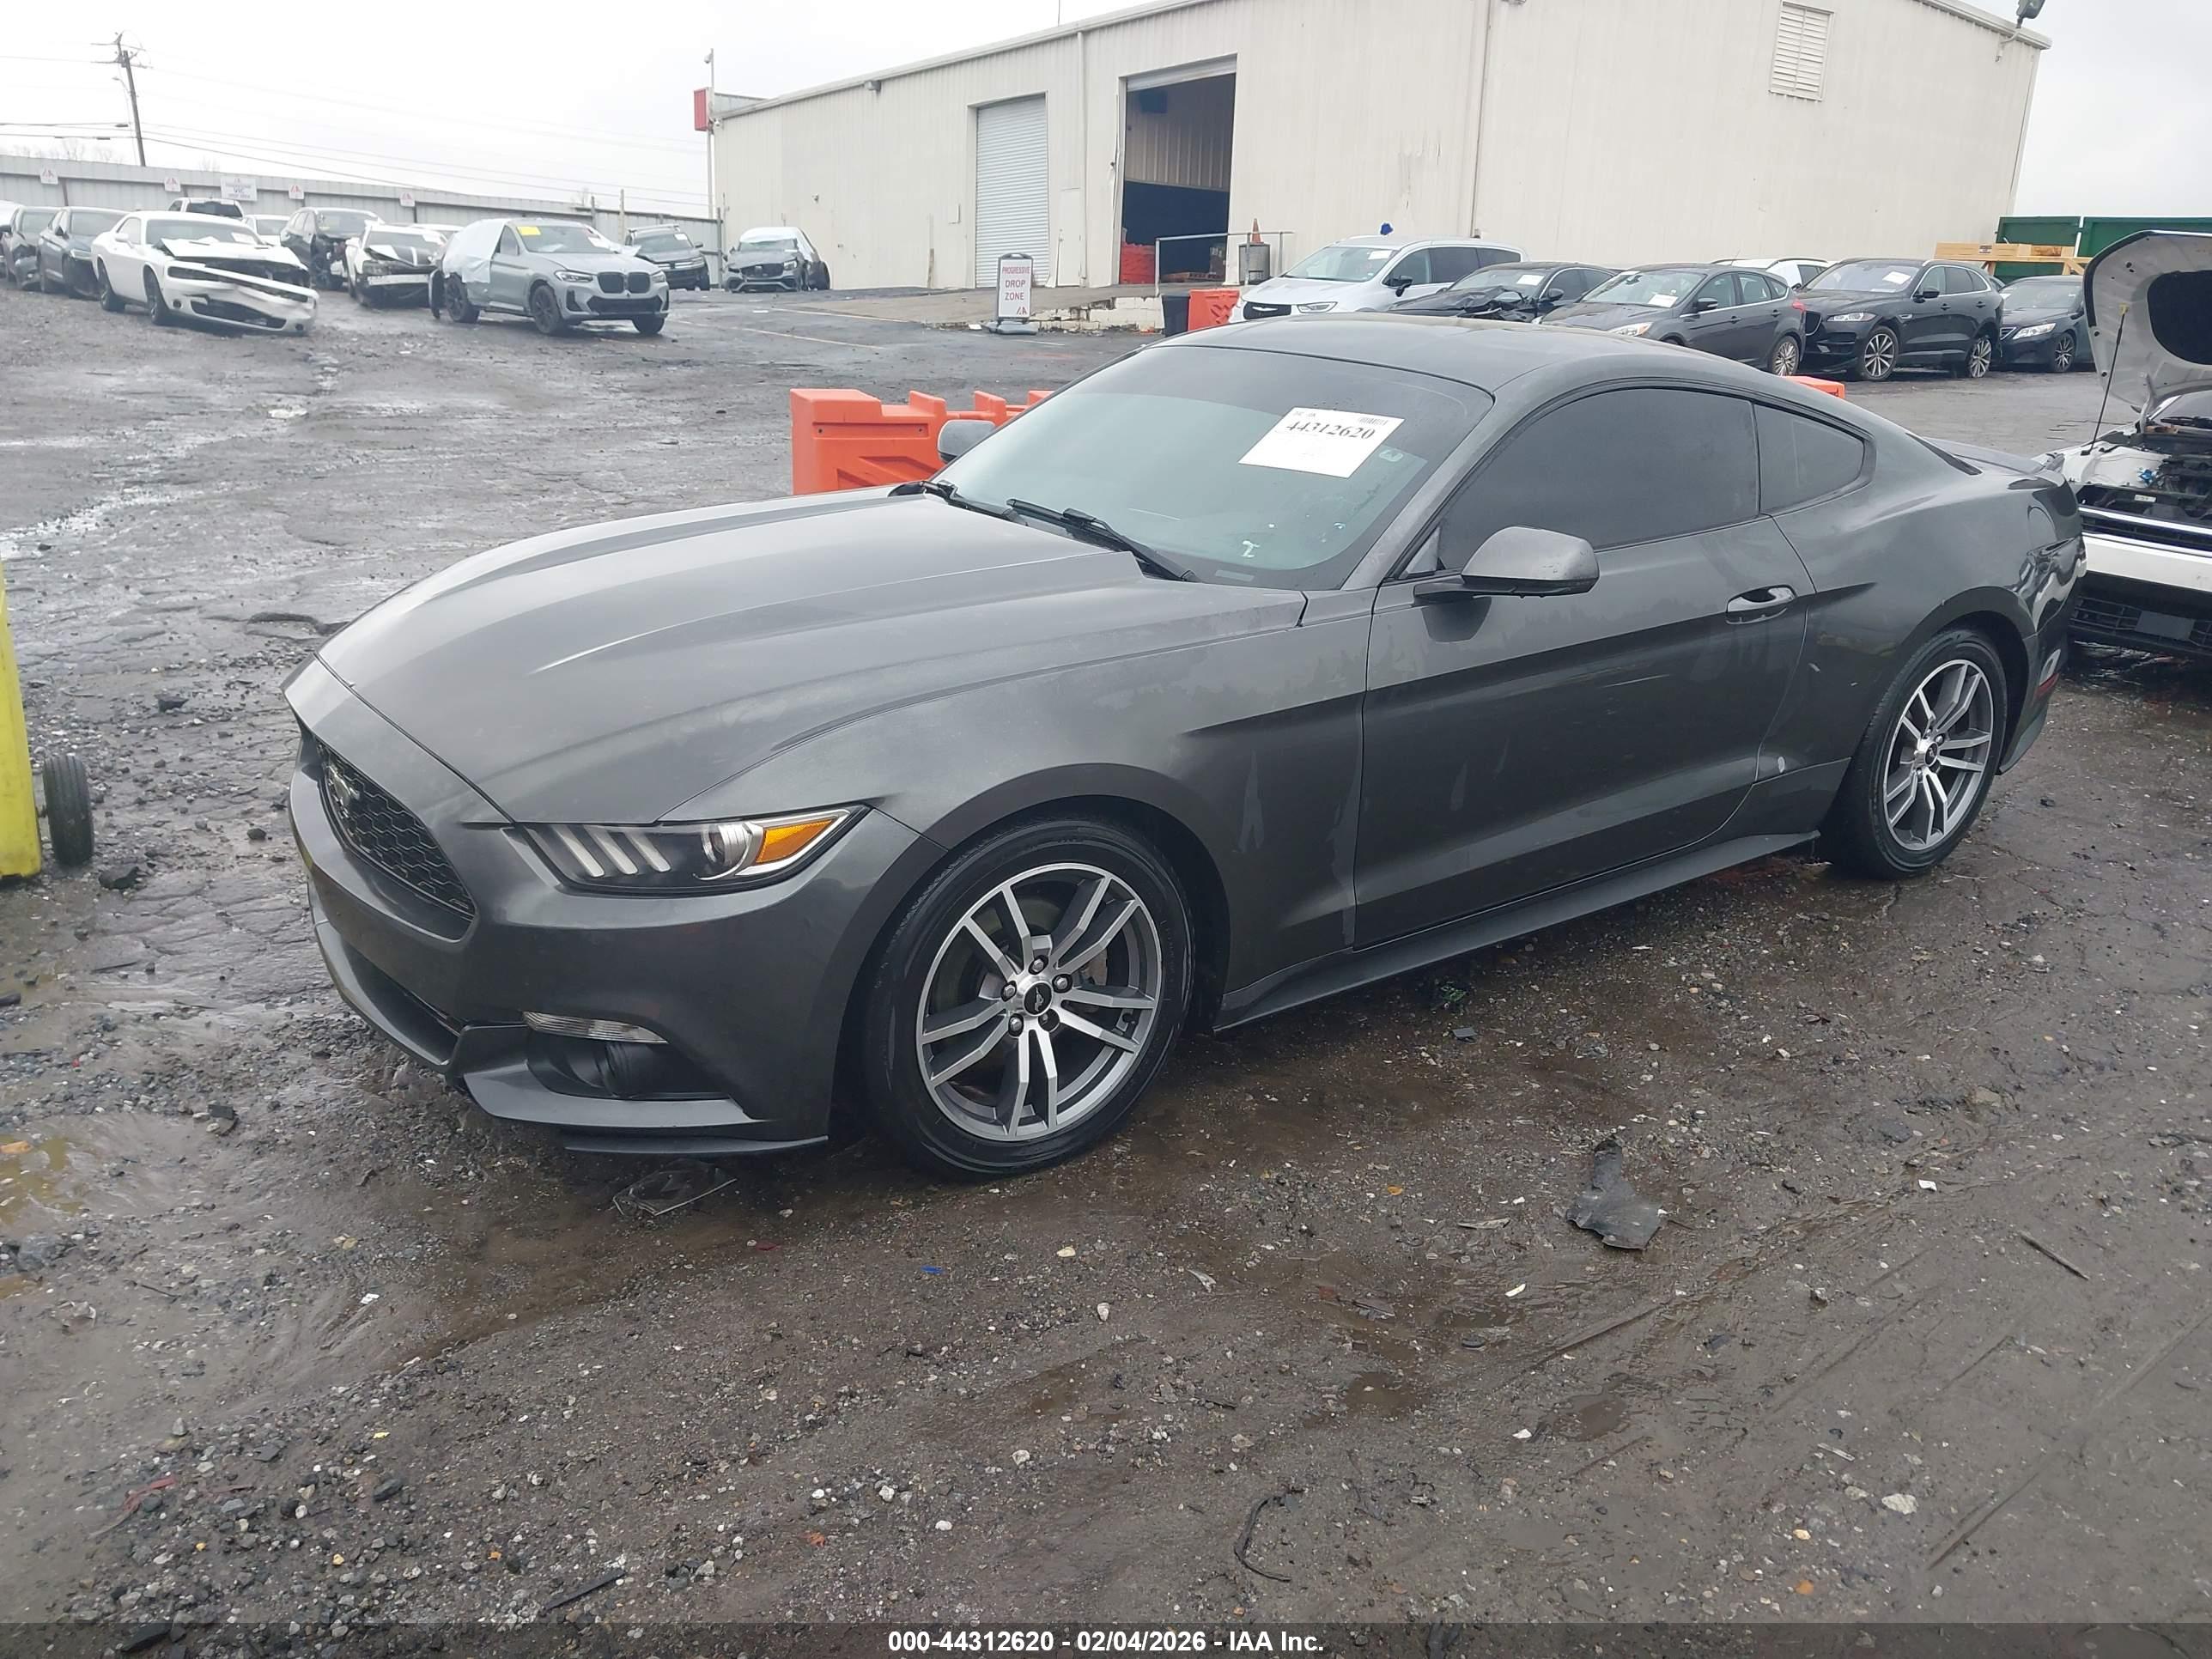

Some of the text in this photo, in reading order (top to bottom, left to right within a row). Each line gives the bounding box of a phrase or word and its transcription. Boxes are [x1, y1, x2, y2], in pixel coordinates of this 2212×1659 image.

[1005, 279, 1026, 289] DROP
[1004, 292, 1024, 301] ZONE
[1286, 421, 1376, 440] 44312620
